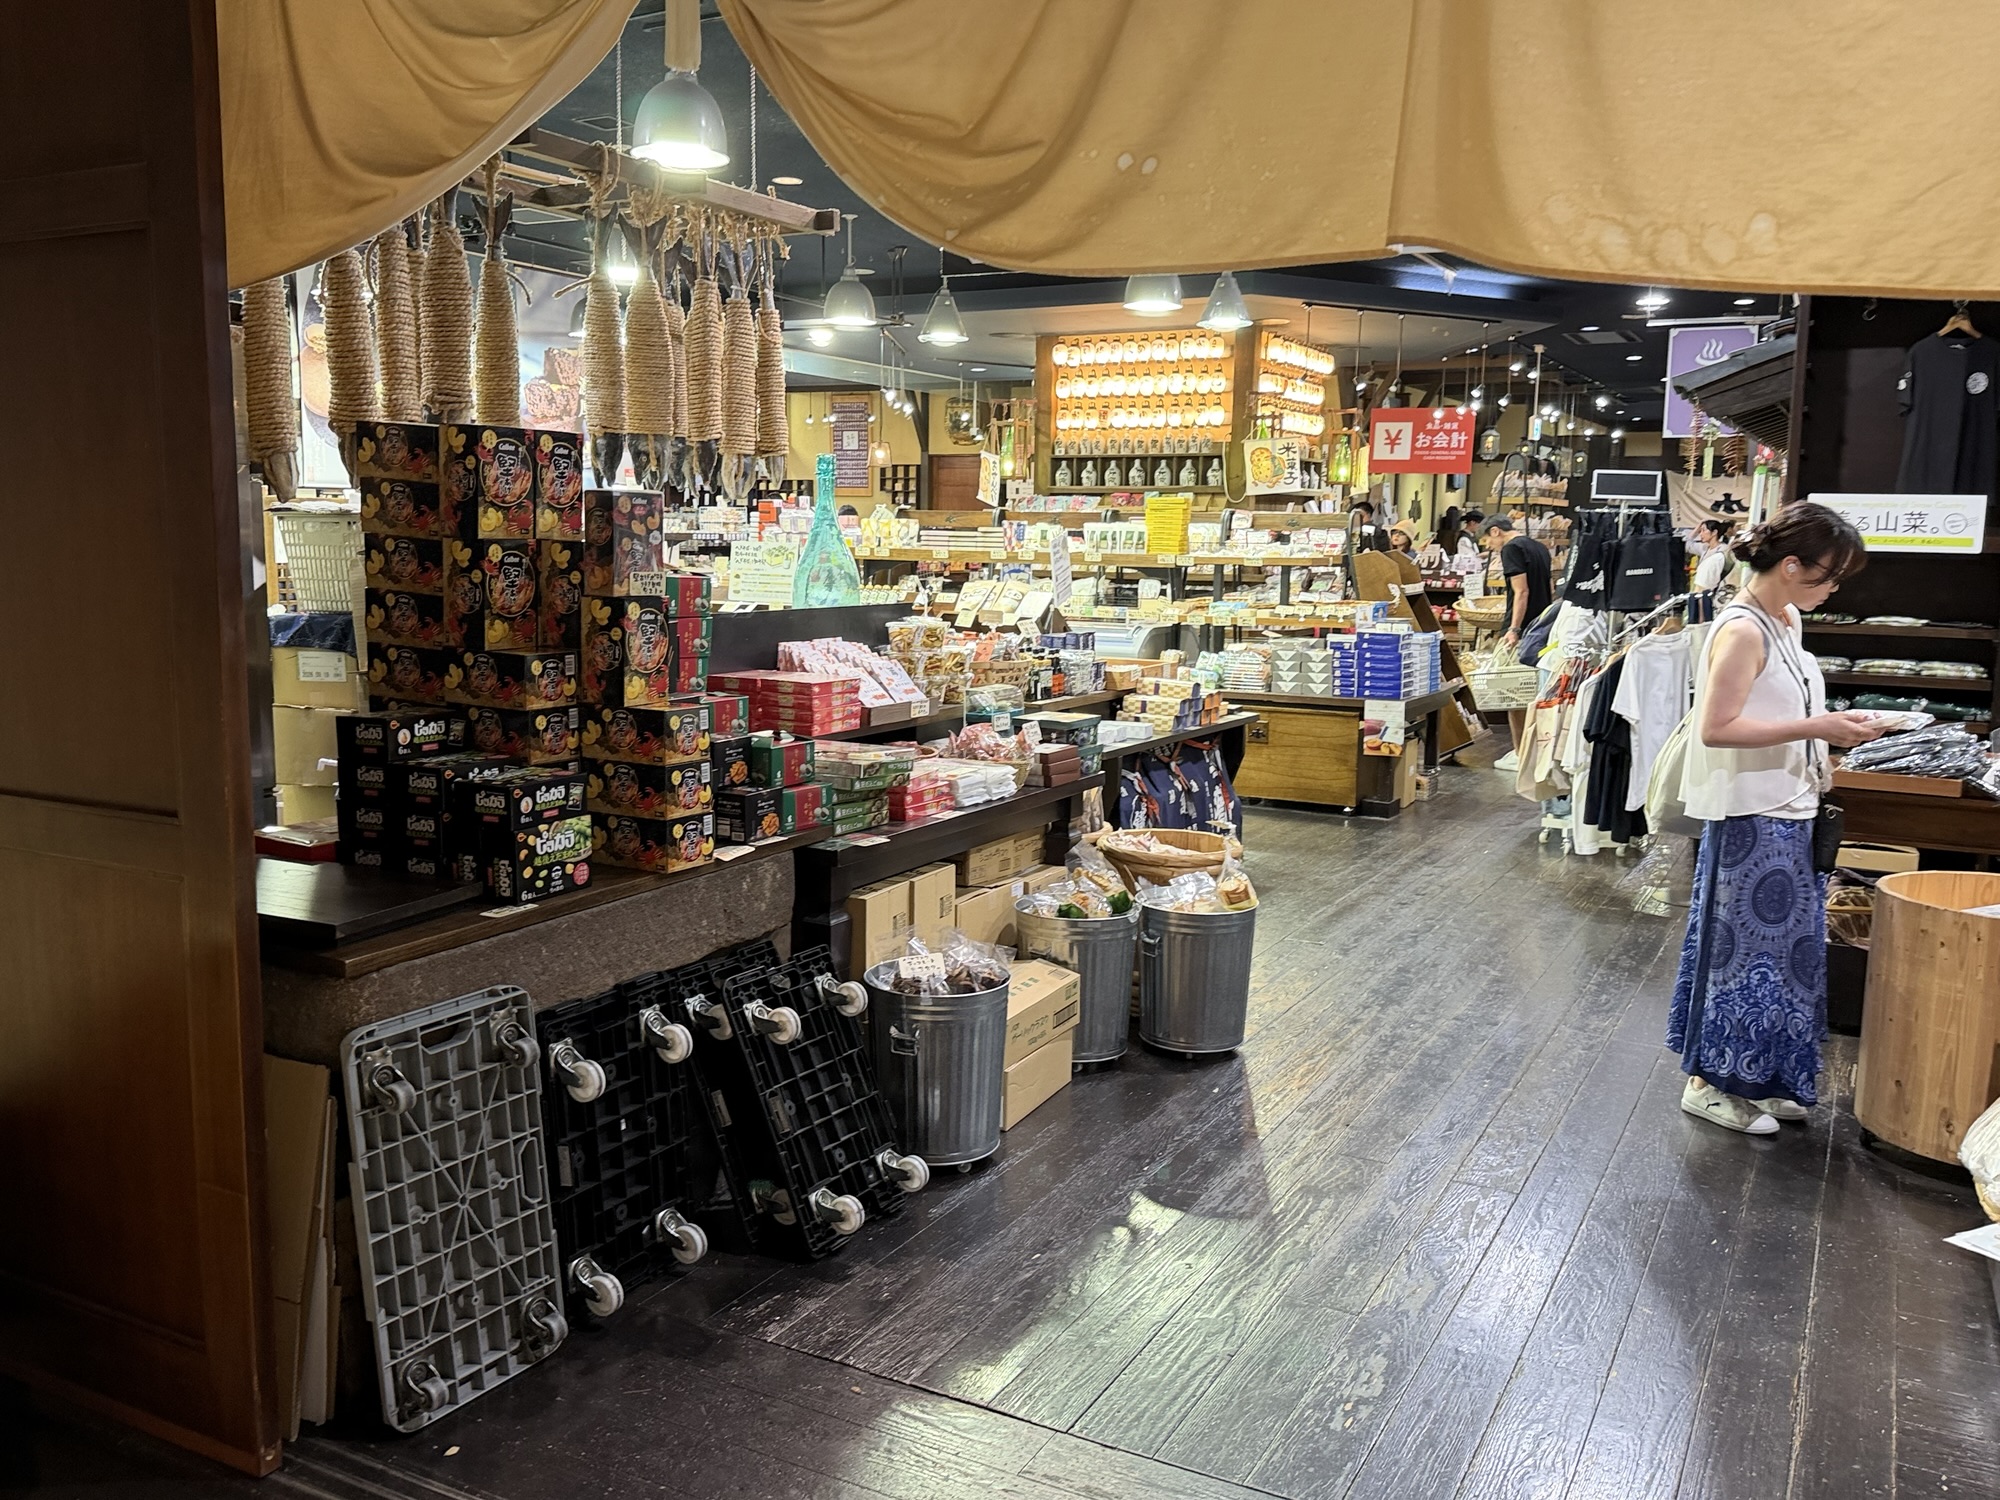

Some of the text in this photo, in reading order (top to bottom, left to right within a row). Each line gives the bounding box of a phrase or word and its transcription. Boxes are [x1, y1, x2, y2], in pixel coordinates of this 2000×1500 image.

[1415, 431, 1467, 448] お会計
[1277, 442, 1299, 486] 米菓子
